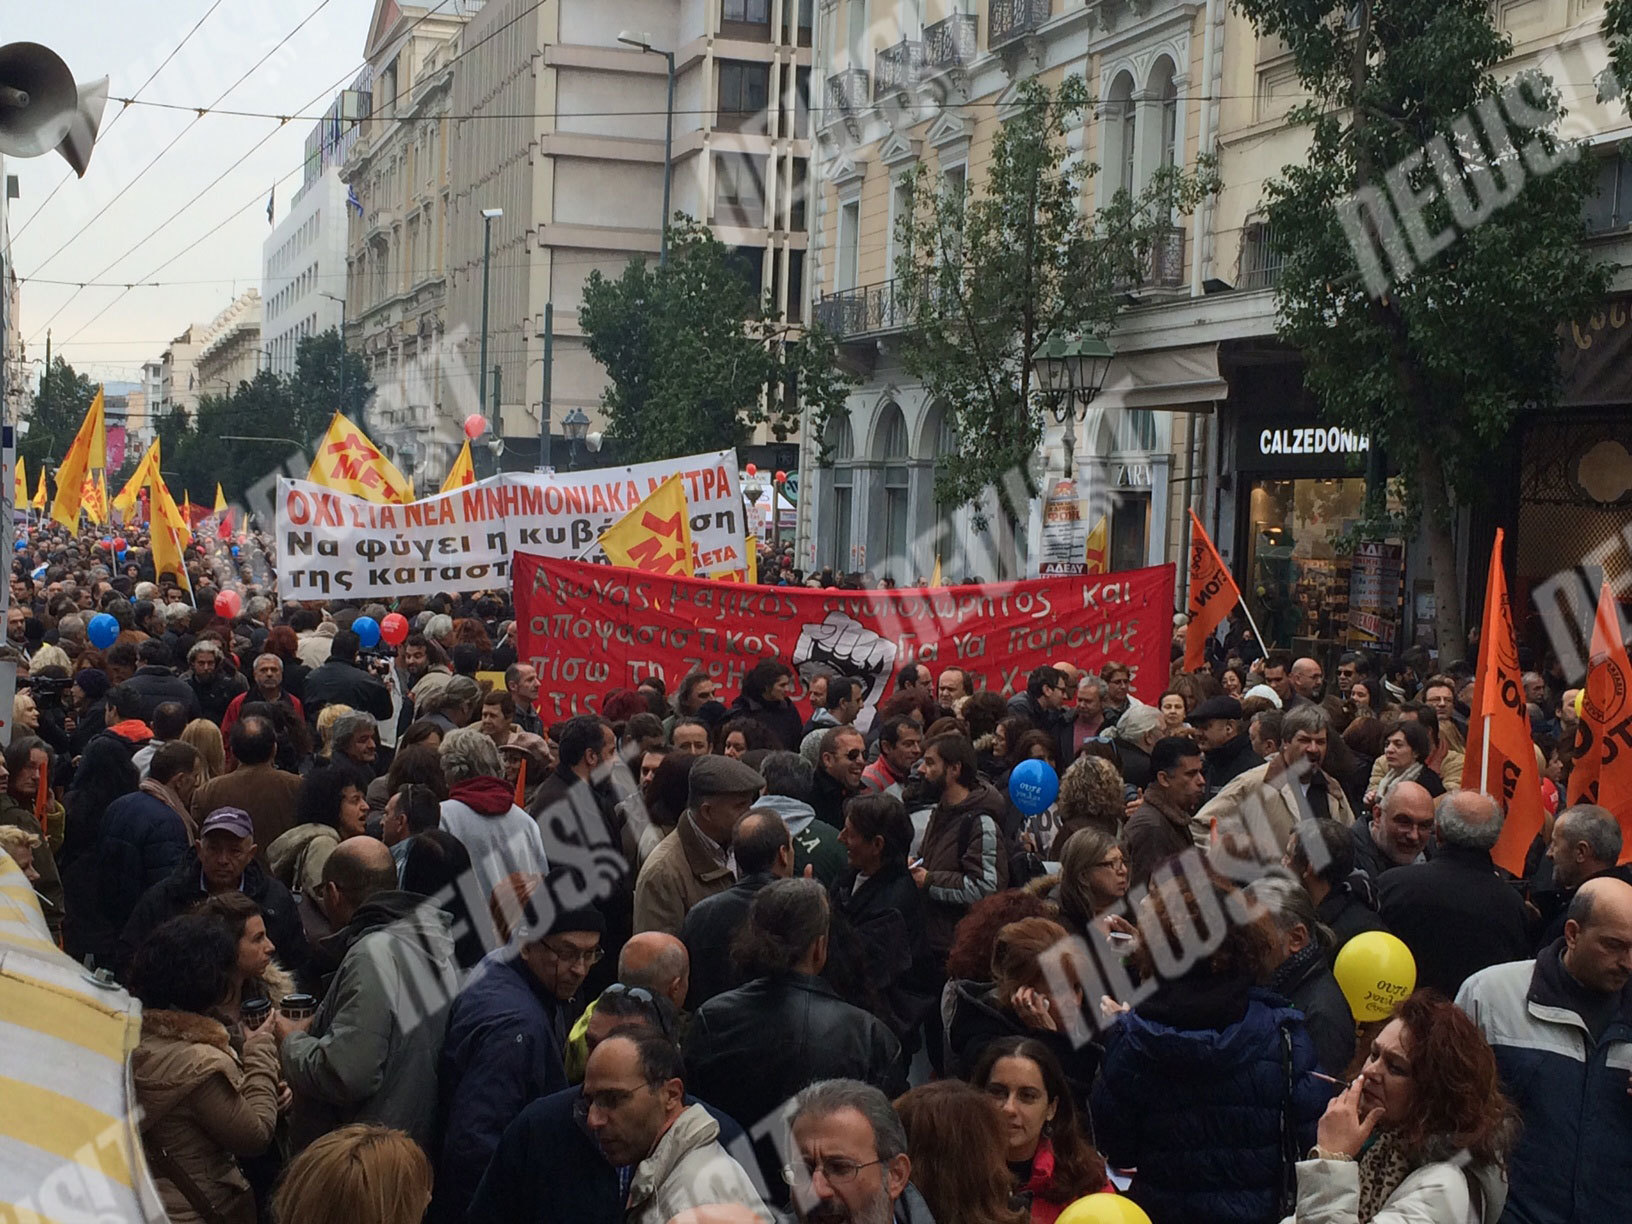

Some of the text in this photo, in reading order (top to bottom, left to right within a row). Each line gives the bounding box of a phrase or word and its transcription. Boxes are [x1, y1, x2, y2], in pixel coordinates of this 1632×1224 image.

[1260, 426, 1369, 454] CALZEDONIA
[287, 490, 345, 527] ΟΧΙ
[404, 497, 456, 528] ΝΕΑ
[462, 479, 642, 523] ΜΝΗΜΟΝΙΑΚΑ
[287, 531, 339, 556] Να
[355, 534, 471, 562] φύγει
[487, 531, 509, 554] η
[288, 569, 353, 594] της
